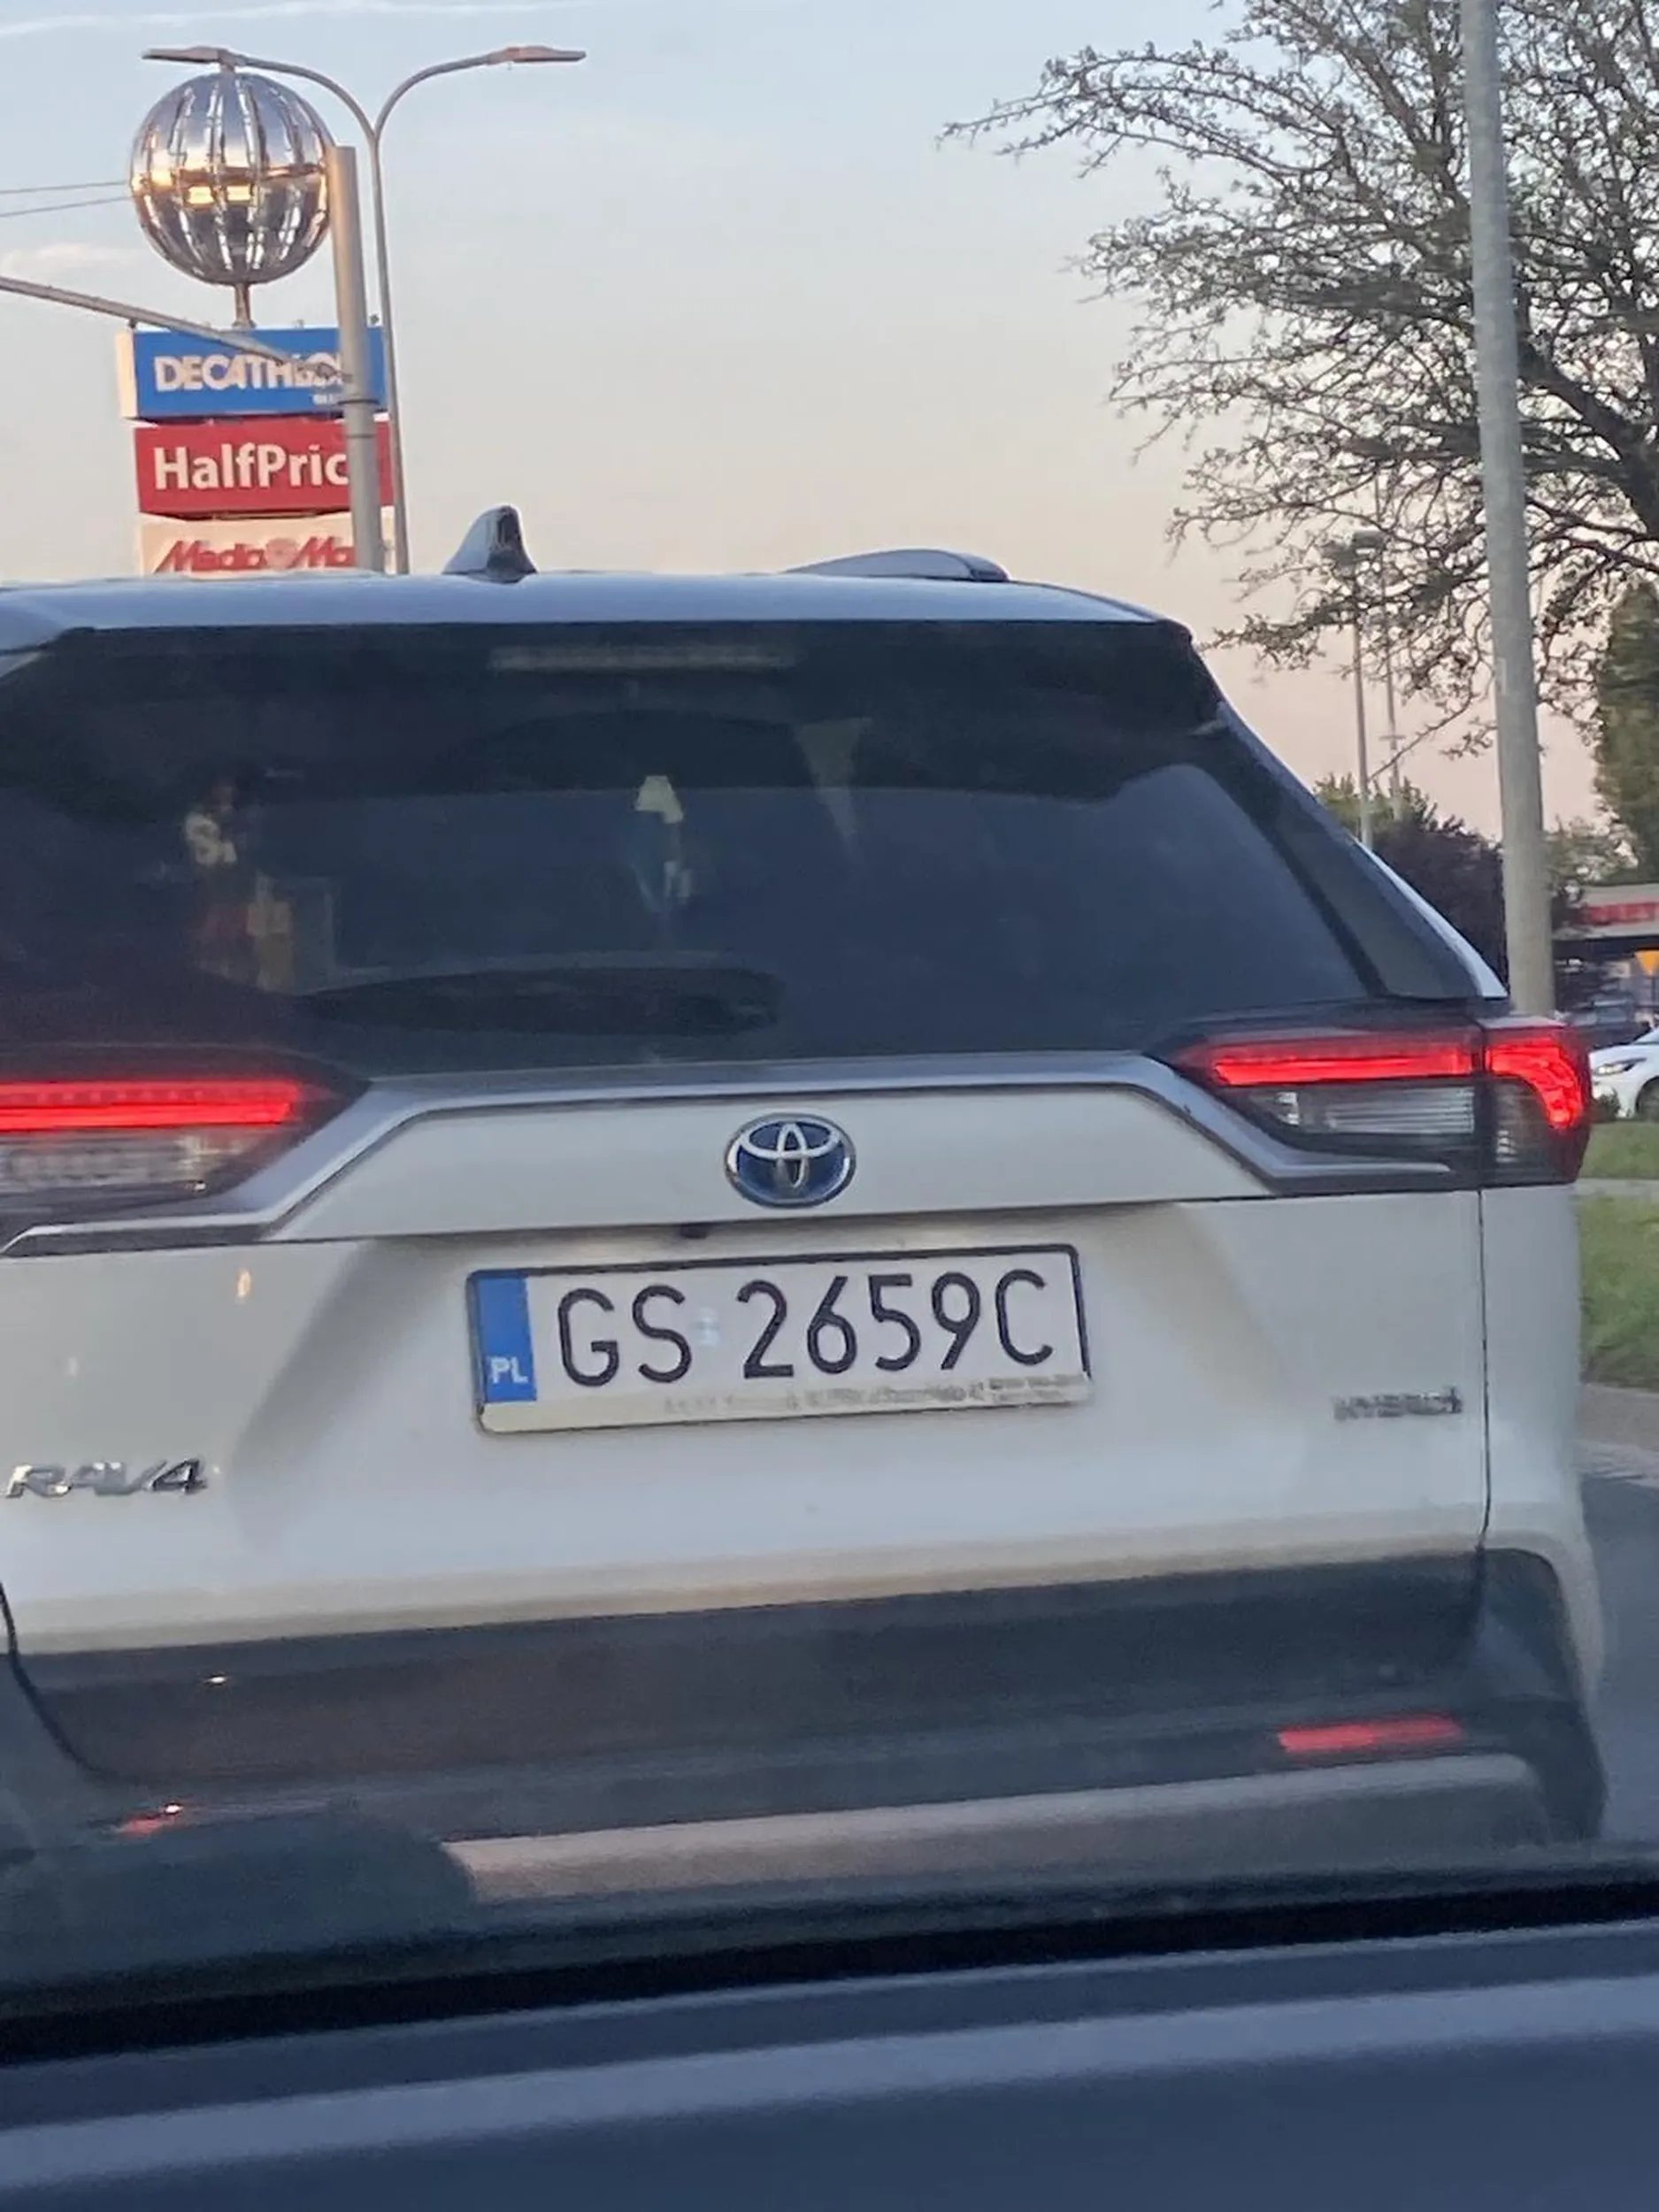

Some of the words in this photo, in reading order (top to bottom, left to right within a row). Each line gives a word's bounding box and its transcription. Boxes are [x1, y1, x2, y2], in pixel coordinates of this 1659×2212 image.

[153, 442, 349, 489] HalfPric
[557, 1285, 692, 1387] GS
[737, 1269, 1054, 1379] 2659C
[491, 1356, 529, 1384] PL
[4, 1458, 209, 1499] RAV4
